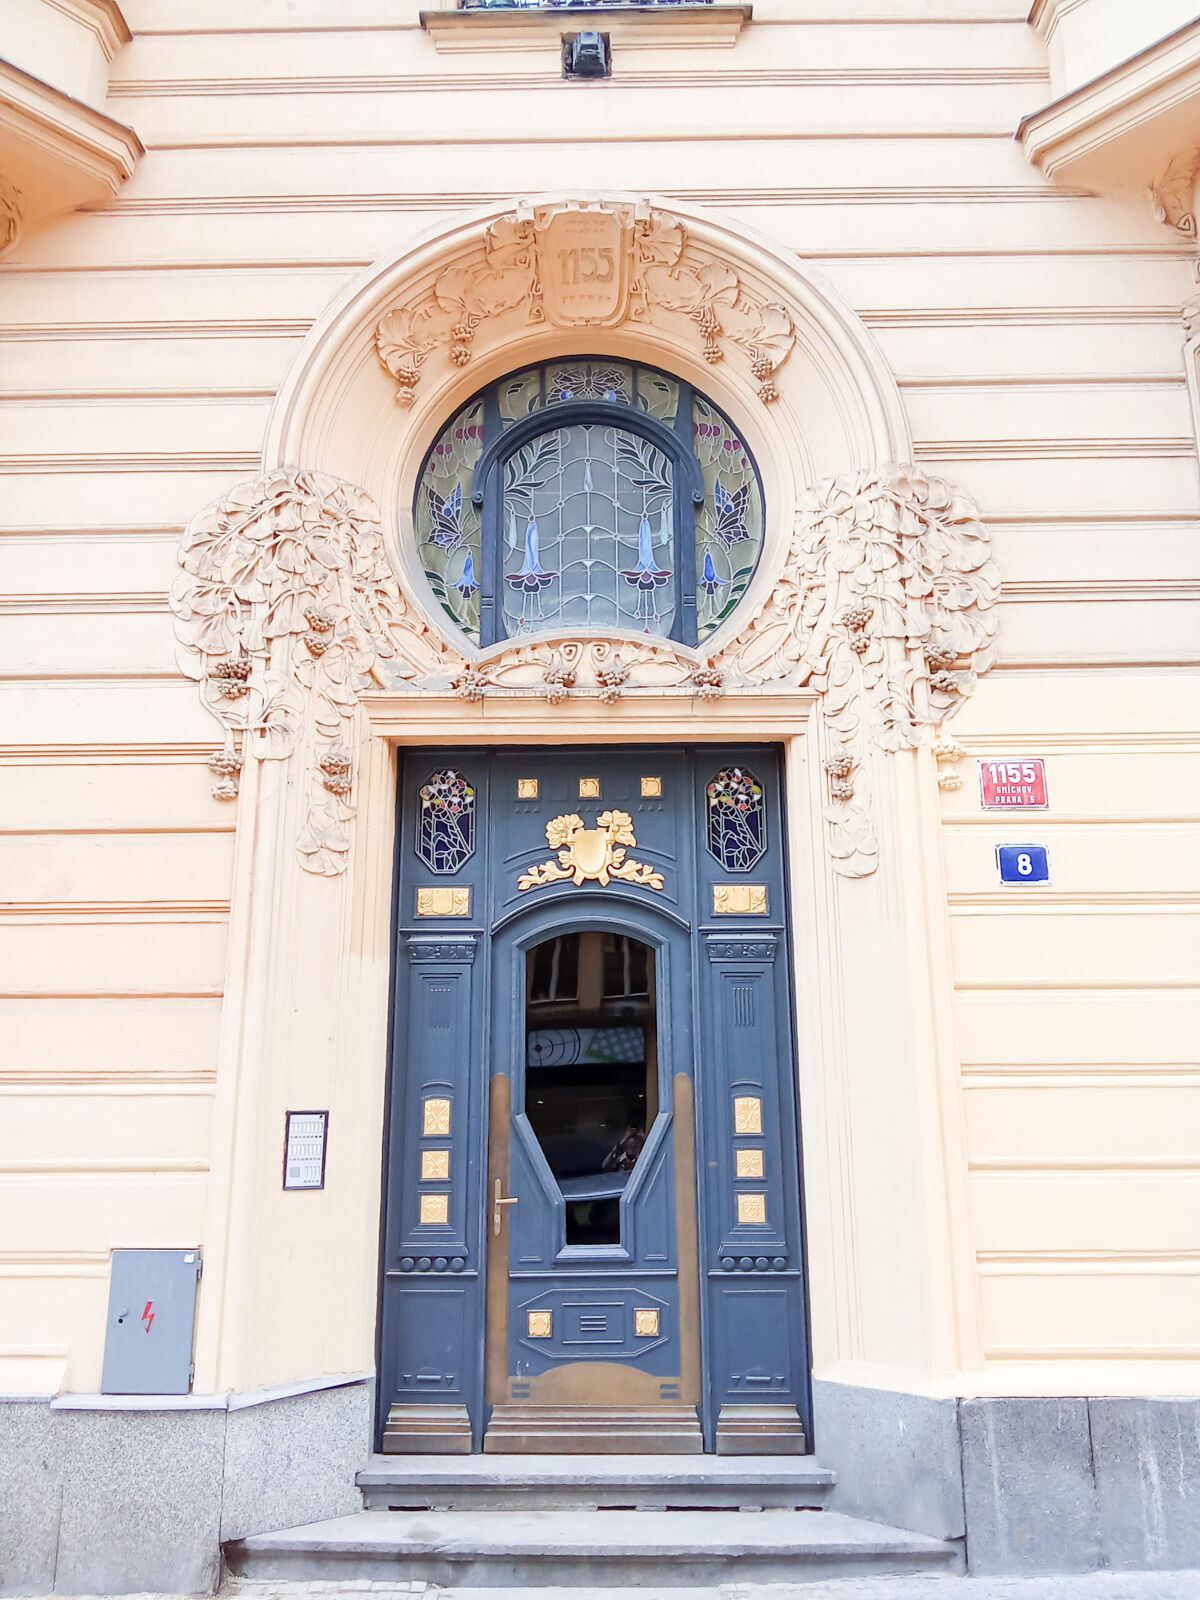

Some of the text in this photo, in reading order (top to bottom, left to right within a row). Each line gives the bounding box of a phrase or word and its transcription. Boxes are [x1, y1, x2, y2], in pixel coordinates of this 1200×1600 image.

[558, 247, 614, 285] 1155
[988, 763, 1036, 784] 1155
[995, 795, 1035, 804] PRAHA 5
[1017, 853, 1033, 876] 8
